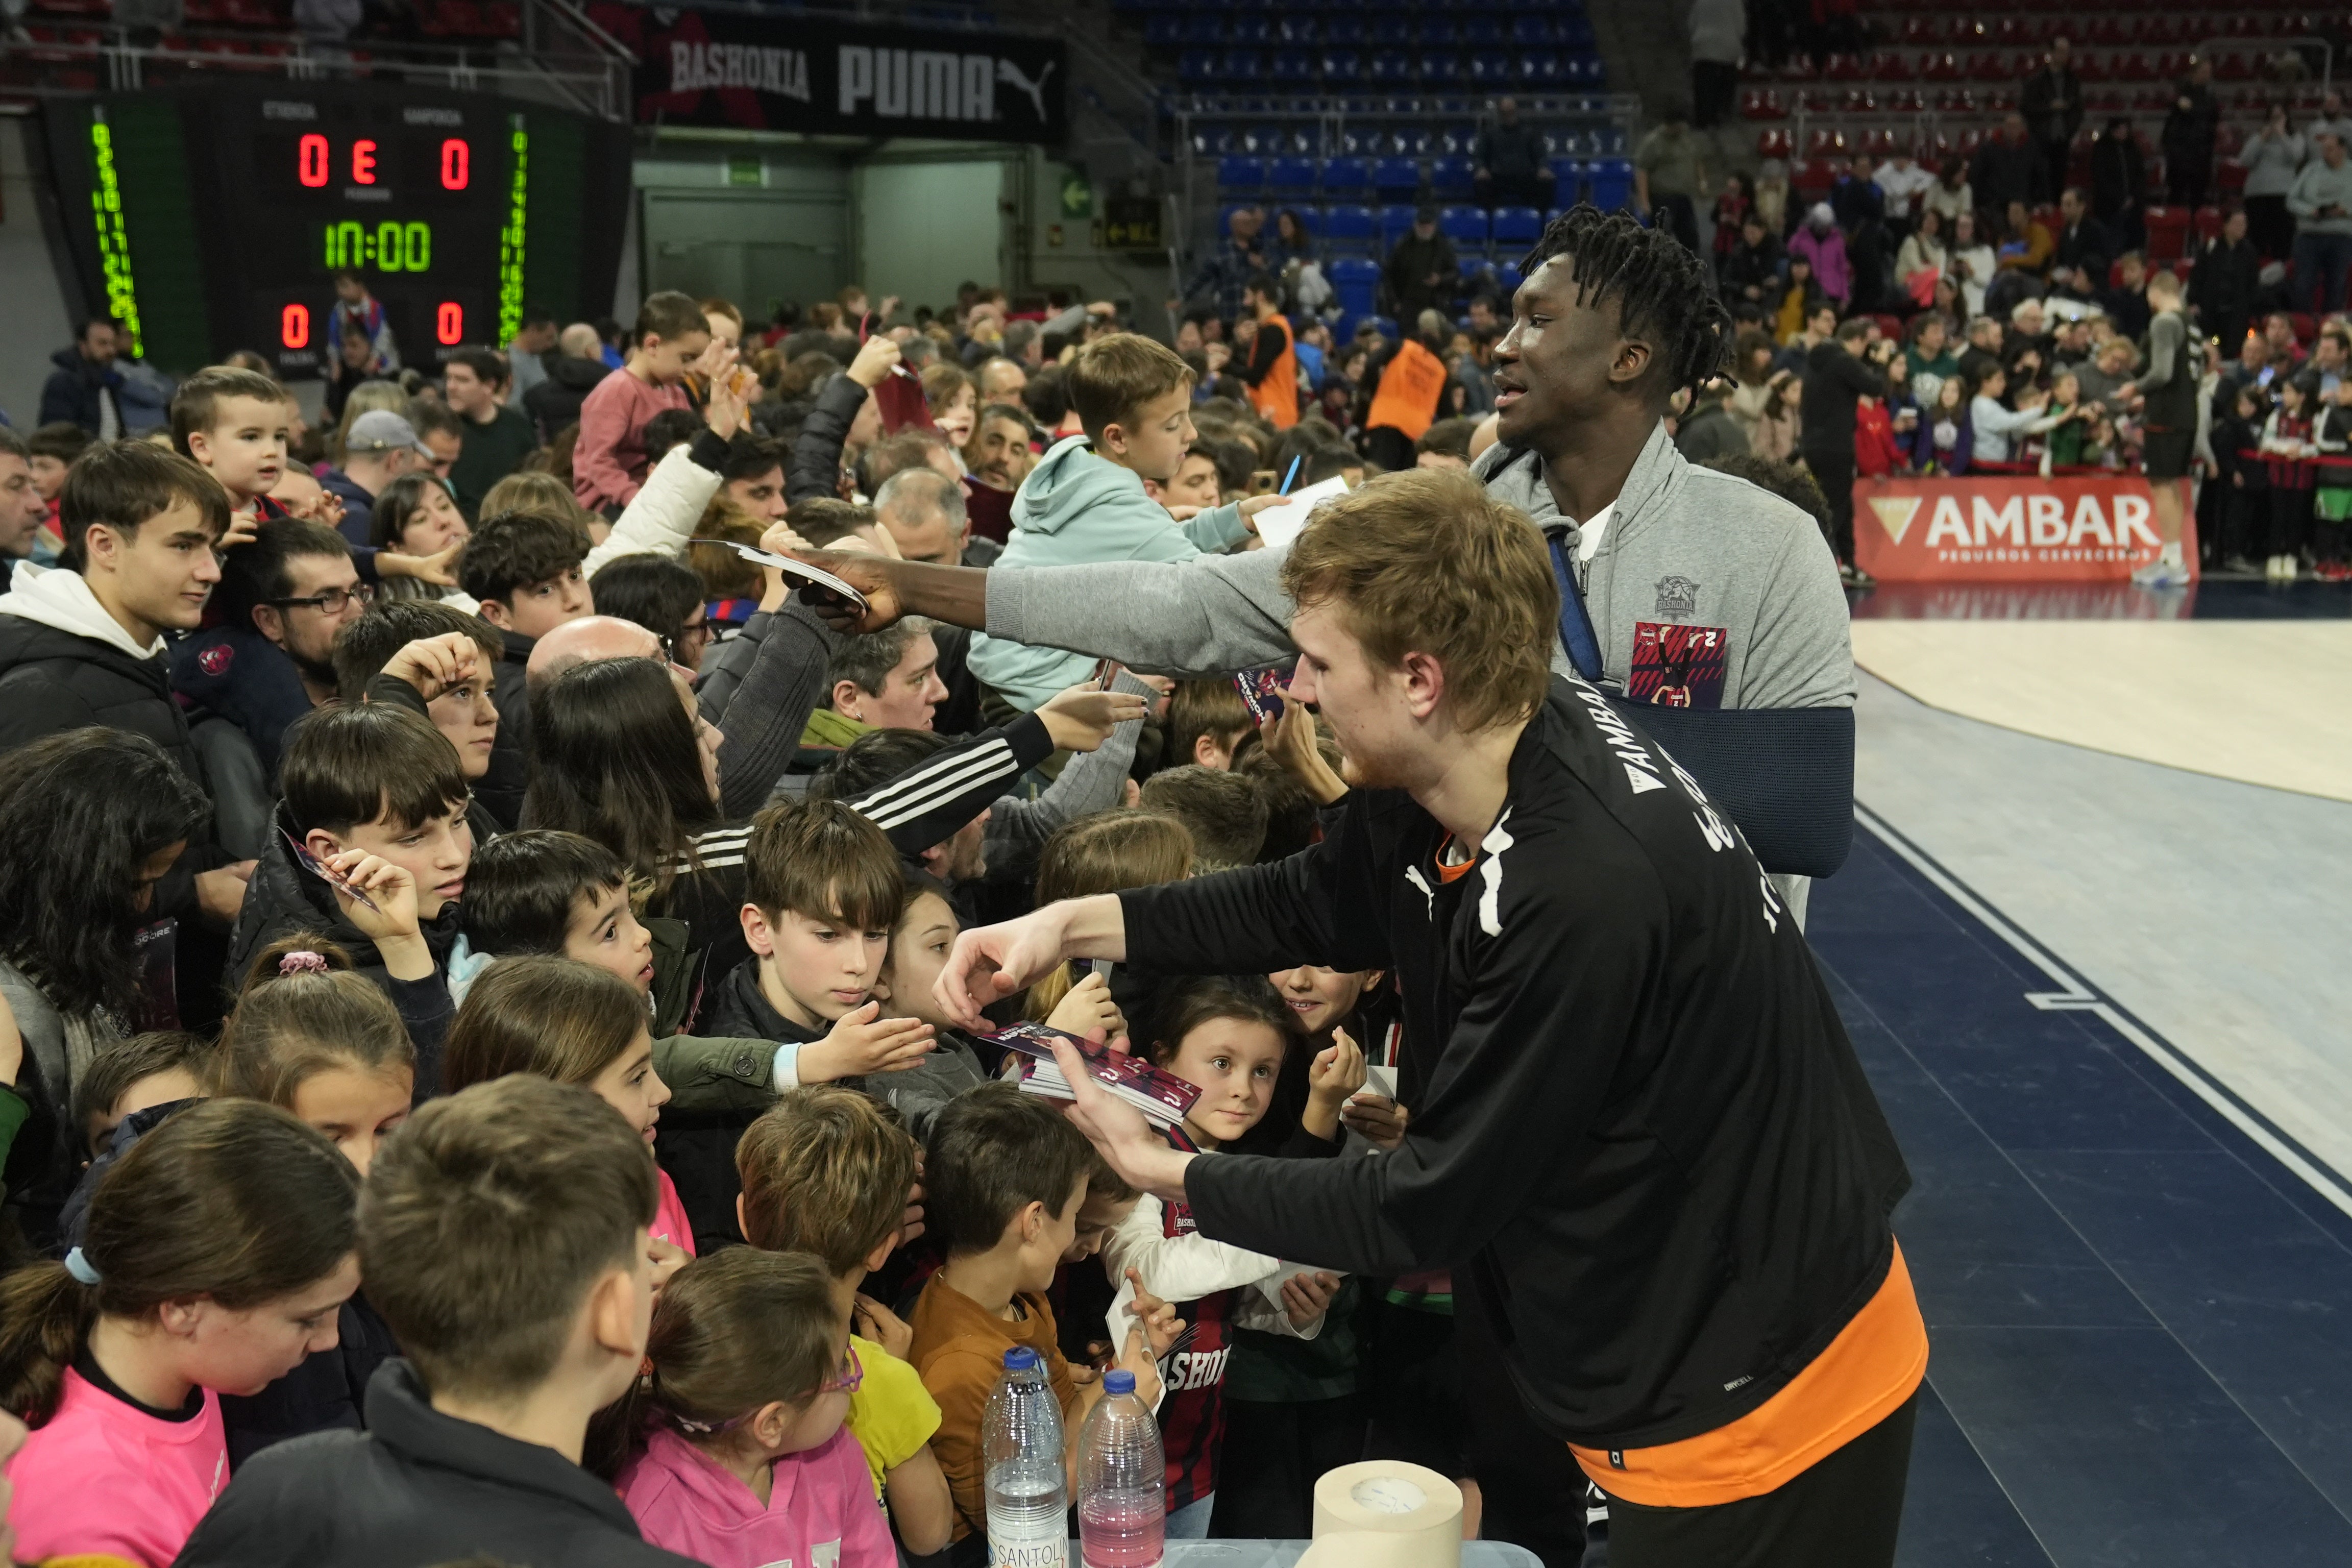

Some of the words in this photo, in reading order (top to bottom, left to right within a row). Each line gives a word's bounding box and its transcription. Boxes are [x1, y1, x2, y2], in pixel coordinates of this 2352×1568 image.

[839, 45, 994, 120] PUMA
[299, 134, 328, 187] 0
[353, 139, 377, 184] E
[442, 138, 469, 190] 0
[282, 304, 308, 348] 0
[437, 301, 462, 345] 0
[1924, 495, 2162, 547] AMBAR
[1705, 631, 1717, 647] 2
[1238, 672, 1265, 721] HOWARD
